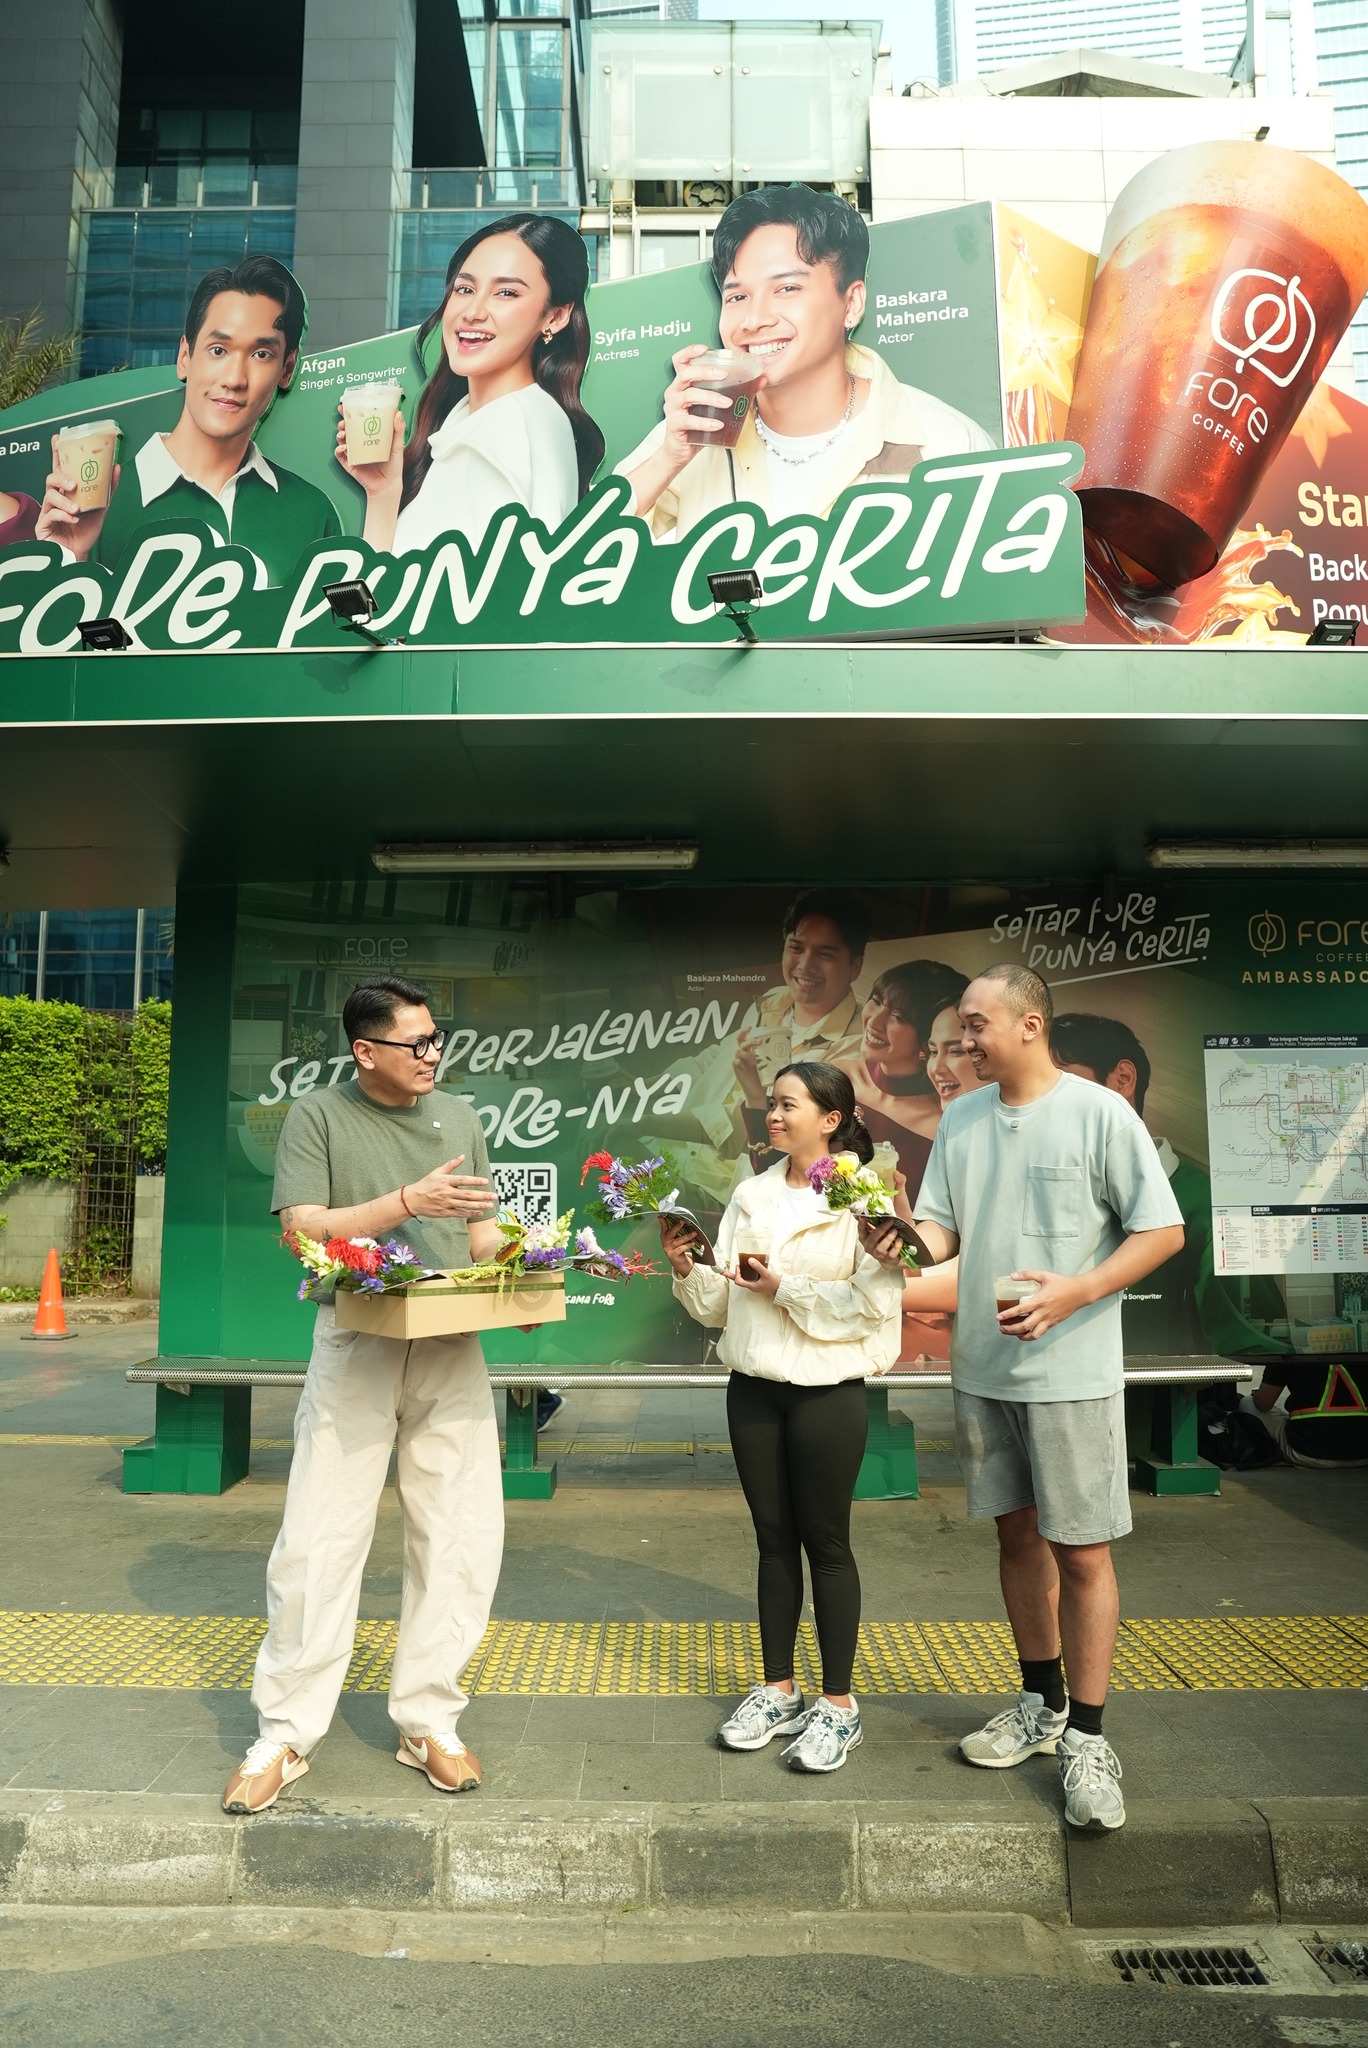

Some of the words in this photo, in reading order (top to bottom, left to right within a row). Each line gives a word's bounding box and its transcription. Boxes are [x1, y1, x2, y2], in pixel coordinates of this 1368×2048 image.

[876, 290, 947, 308] Baskara
[876, 306, 969, 328] Mahendra
[594, 327, 636, 347] Syifa
[640, 320, 691, 339] Hadju
[878, 333, 915, 345] Actor
[594, 348, 640, 362] Actress
[300, 357, 346, 374] Afgan
[300, 378, 335, 390] Singer
[336, 374, 344, 384] &
[346, 366, 407, 382] Songwriter
[1192, 413, 1245, 456] COFFEE
[10, 441, 40, 455] Dara
[686, 974, 721, 982] Baskara
[722, 974, 766, 982] Mahendra
